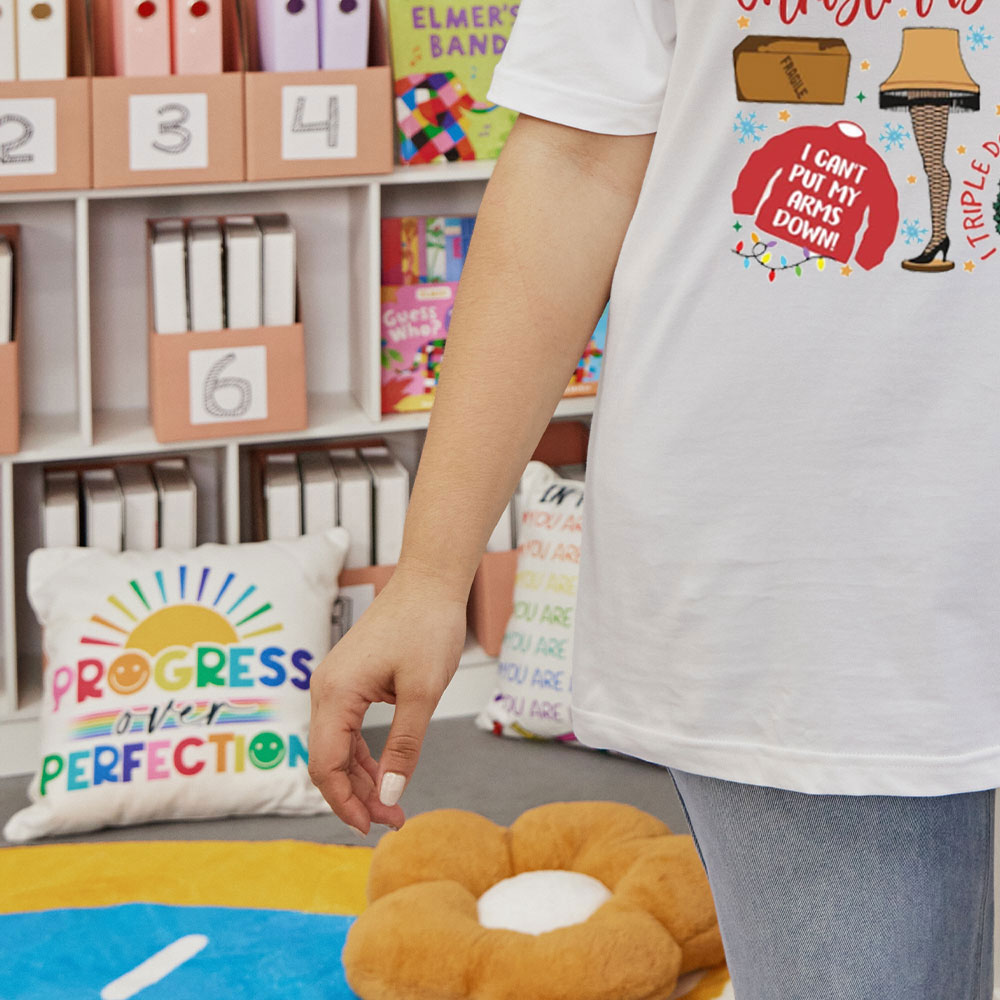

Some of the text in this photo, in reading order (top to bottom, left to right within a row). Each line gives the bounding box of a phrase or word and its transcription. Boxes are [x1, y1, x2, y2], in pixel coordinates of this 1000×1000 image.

[429, 33, 508, 59] BAND
[779, 55, 810, 101] FRAGILE
[0, 112, 34, 164] 2
[152, 103, 191, 155] 3
[290, 95, 339, 148] 4
[801, 143, 868, 184] I CAN'T
[787, 165, 862, 209] PUT MY
[960, 158, 992, 250] TRIPLE
[787, 189, 843, 227] ARMS
[772, 207, 842, 252] DOWN!
[980, 246, 997, 261] I
[382, 306, 438, 327] Guess
[387, 318, 442, 343] Who?
[205, 353, 252, 418] 6
[540, 603, 573, 628] ARE
[535, 635, 567, 660] ARE
[53, 646, 314, 713] PROGRESS
[531, 667, 565, 692] ARE
[115, 699, 242, 735] over
[529, 699, 562, 721] ARE
[39, 731, 310, 797] PERFECTION
